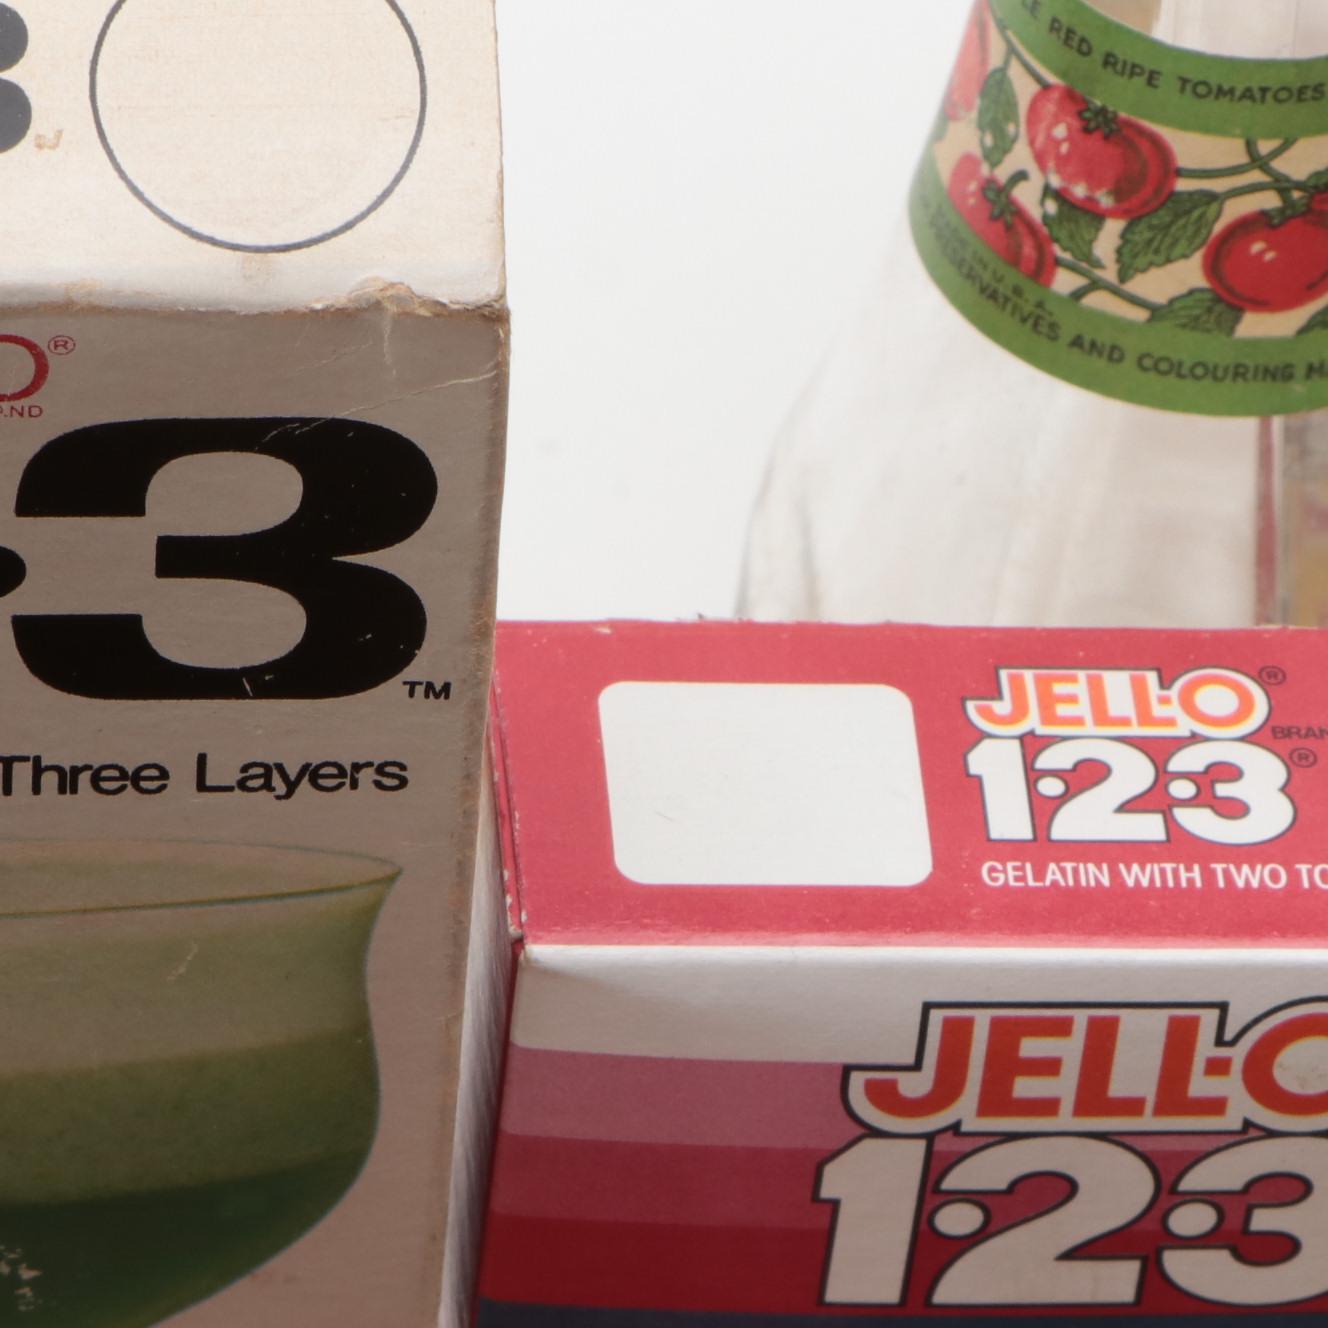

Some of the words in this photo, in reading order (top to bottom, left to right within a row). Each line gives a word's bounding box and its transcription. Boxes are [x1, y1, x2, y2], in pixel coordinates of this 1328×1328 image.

[1049, 14, 1094, 58] RED
[1101, 50, 1163, 90] RIPE
[1176, 75, 1328, 105] TOMATOES
[1067, 326, 1126, 366] AND
[1135, 351, 1296, 386] COLOURING
[967, 667, 1266, 736] JELL-O
[195, 751, 410, 801] Layers
[980, 860, 1111, 888] GELATIN
[1119, 863, 1203, 888] WITH
[1211, 863, 1288, 889] TWO
